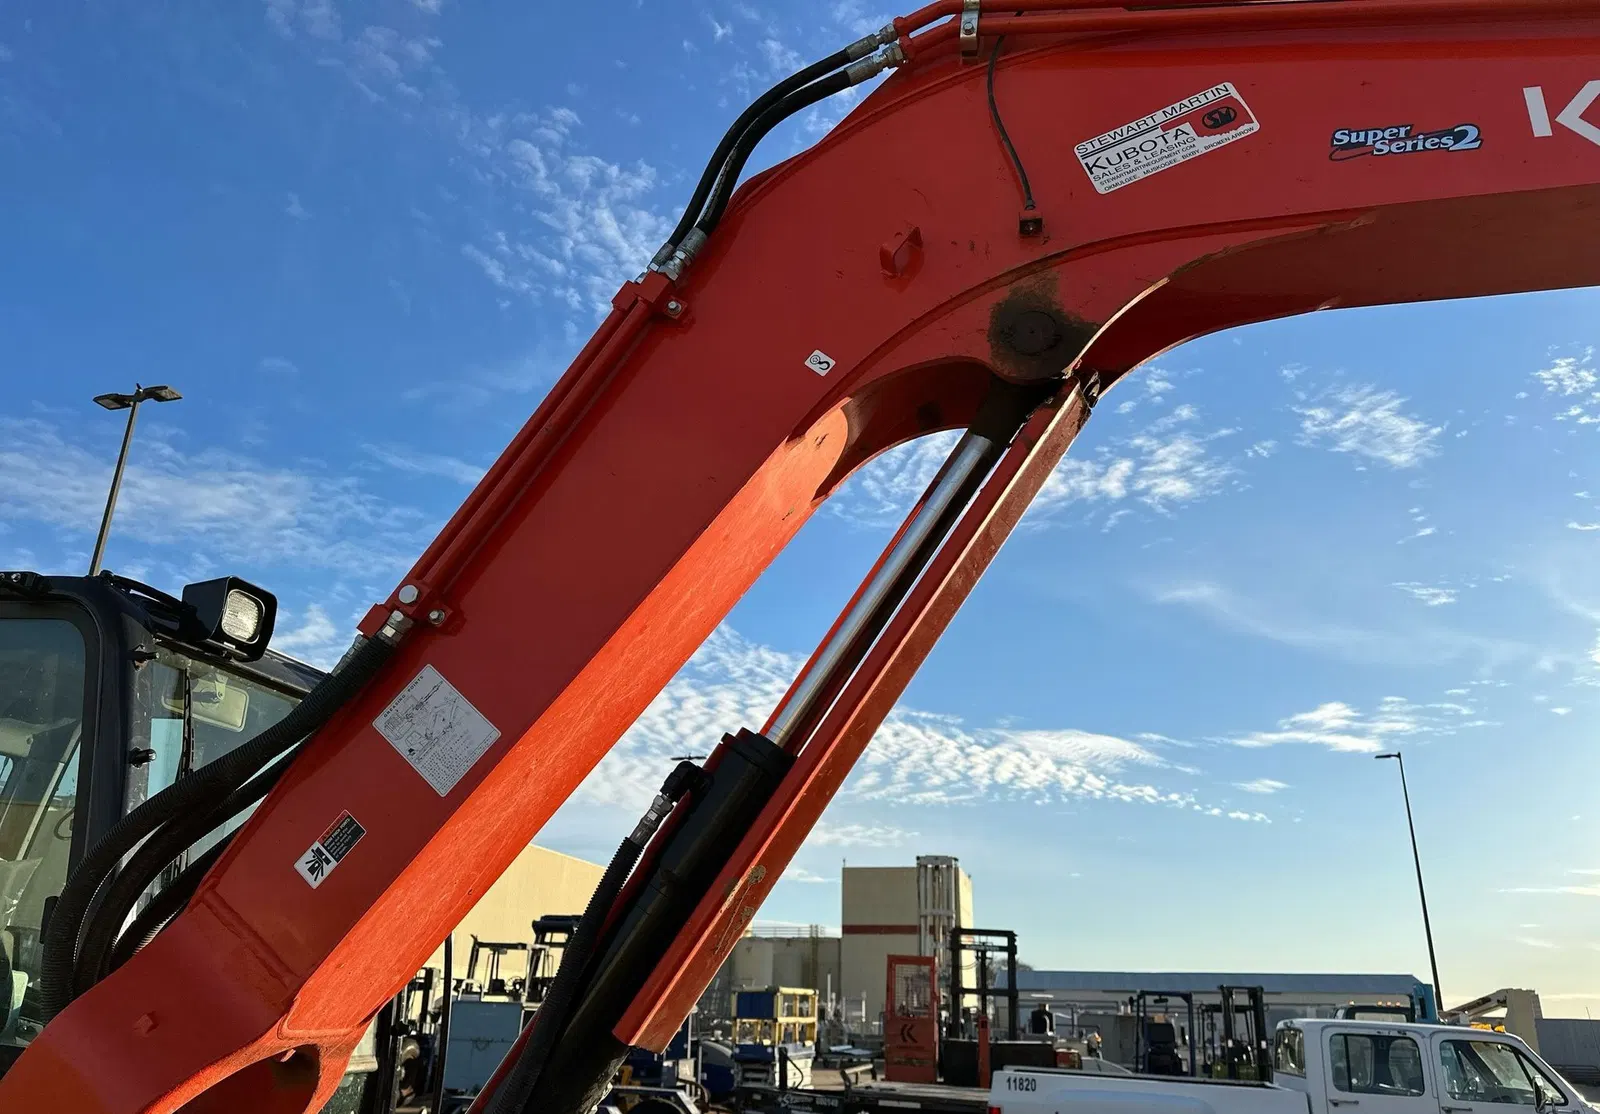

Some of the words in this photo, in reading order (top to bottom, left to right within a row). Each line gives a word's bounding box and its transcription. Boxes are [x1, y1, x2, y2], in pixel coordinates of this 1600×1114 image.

[1076, 114, 1157, 154] STEWART
[1162, 84, 1229, 118] MARTIN
[1204, 137, 1230, 150] BROKEN
[1231, 126, 1255, 140] ARROW
[1333, 125, 1411, 145] Super
[1085, 128, 1190, 175] KUBOTA
[1093, 162, 1131, 182] SALES
[1144, 136, 1196, 160] LEASING
[383, 694, 406, 718] GREASING
[407, 675, 424, 692] POINTS
[1006, 1076, 1037, 1092] 11820
